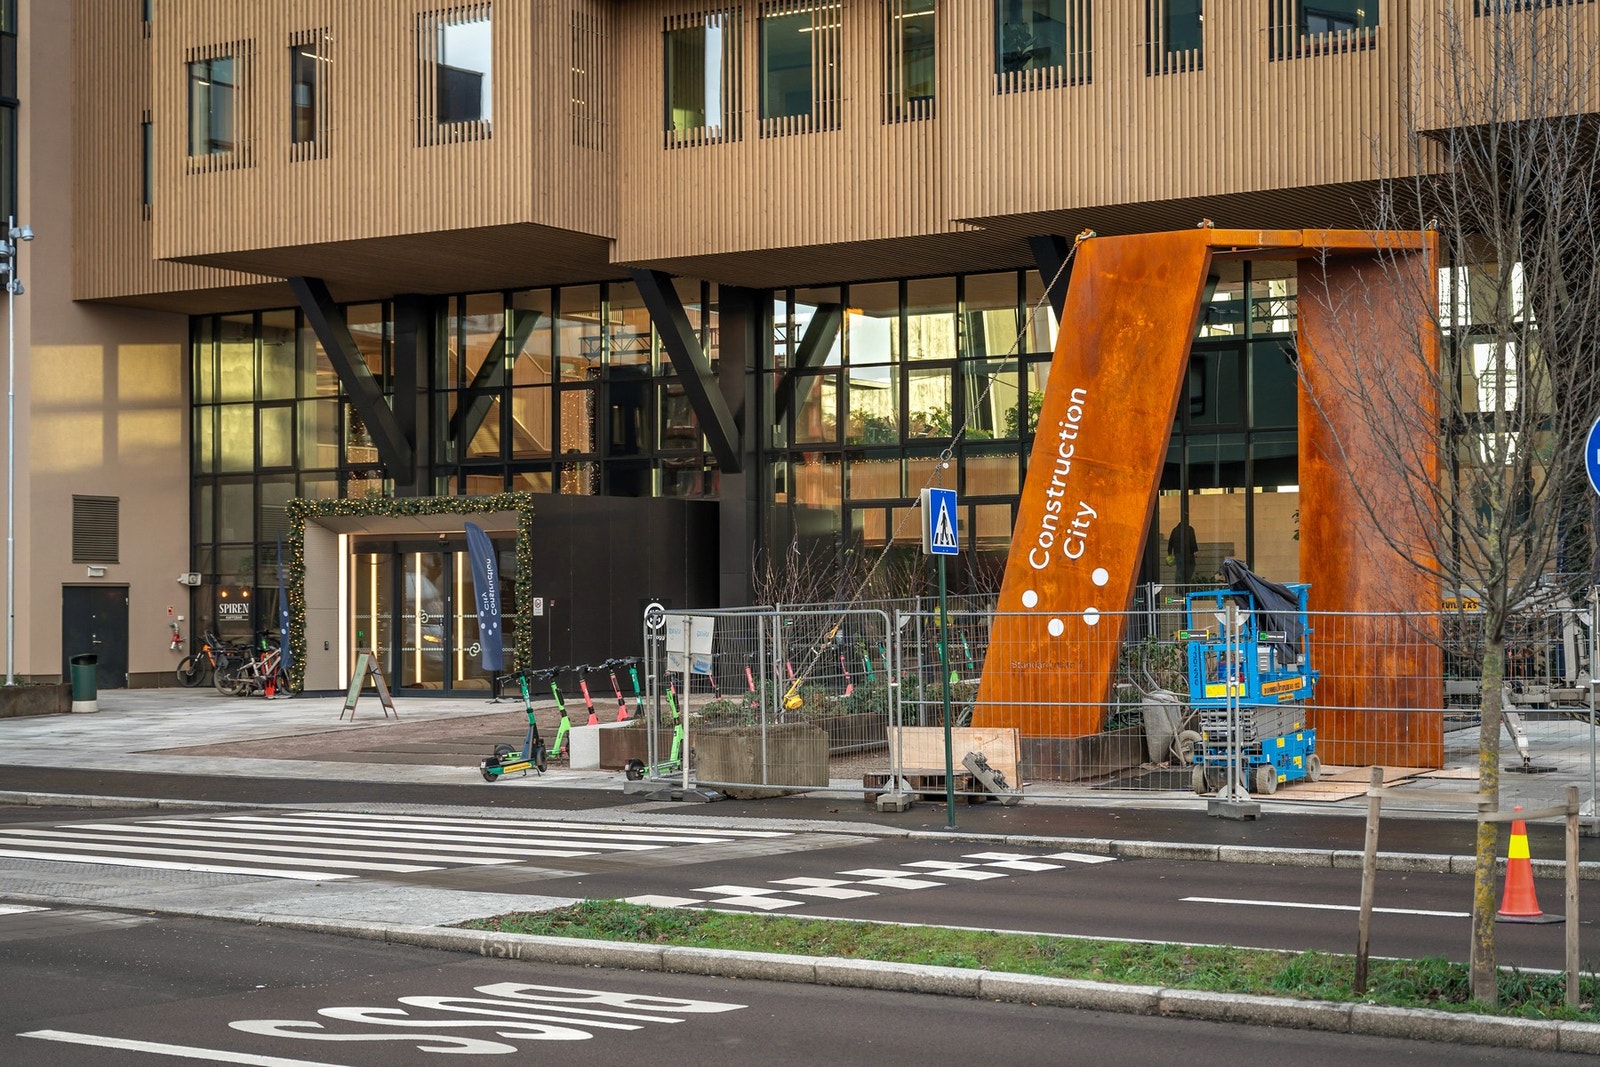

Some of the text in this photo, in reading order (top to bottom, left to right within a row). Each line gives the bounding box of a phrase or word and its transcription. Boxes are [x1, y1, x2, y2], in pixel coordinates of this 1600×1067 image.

[1029, 387, 1087, 570] Construction
[1063, 501, 1098, 560] City
[219, 603, 249, 614] SPIREN
[228, 982, 749, 1055] BUSS
